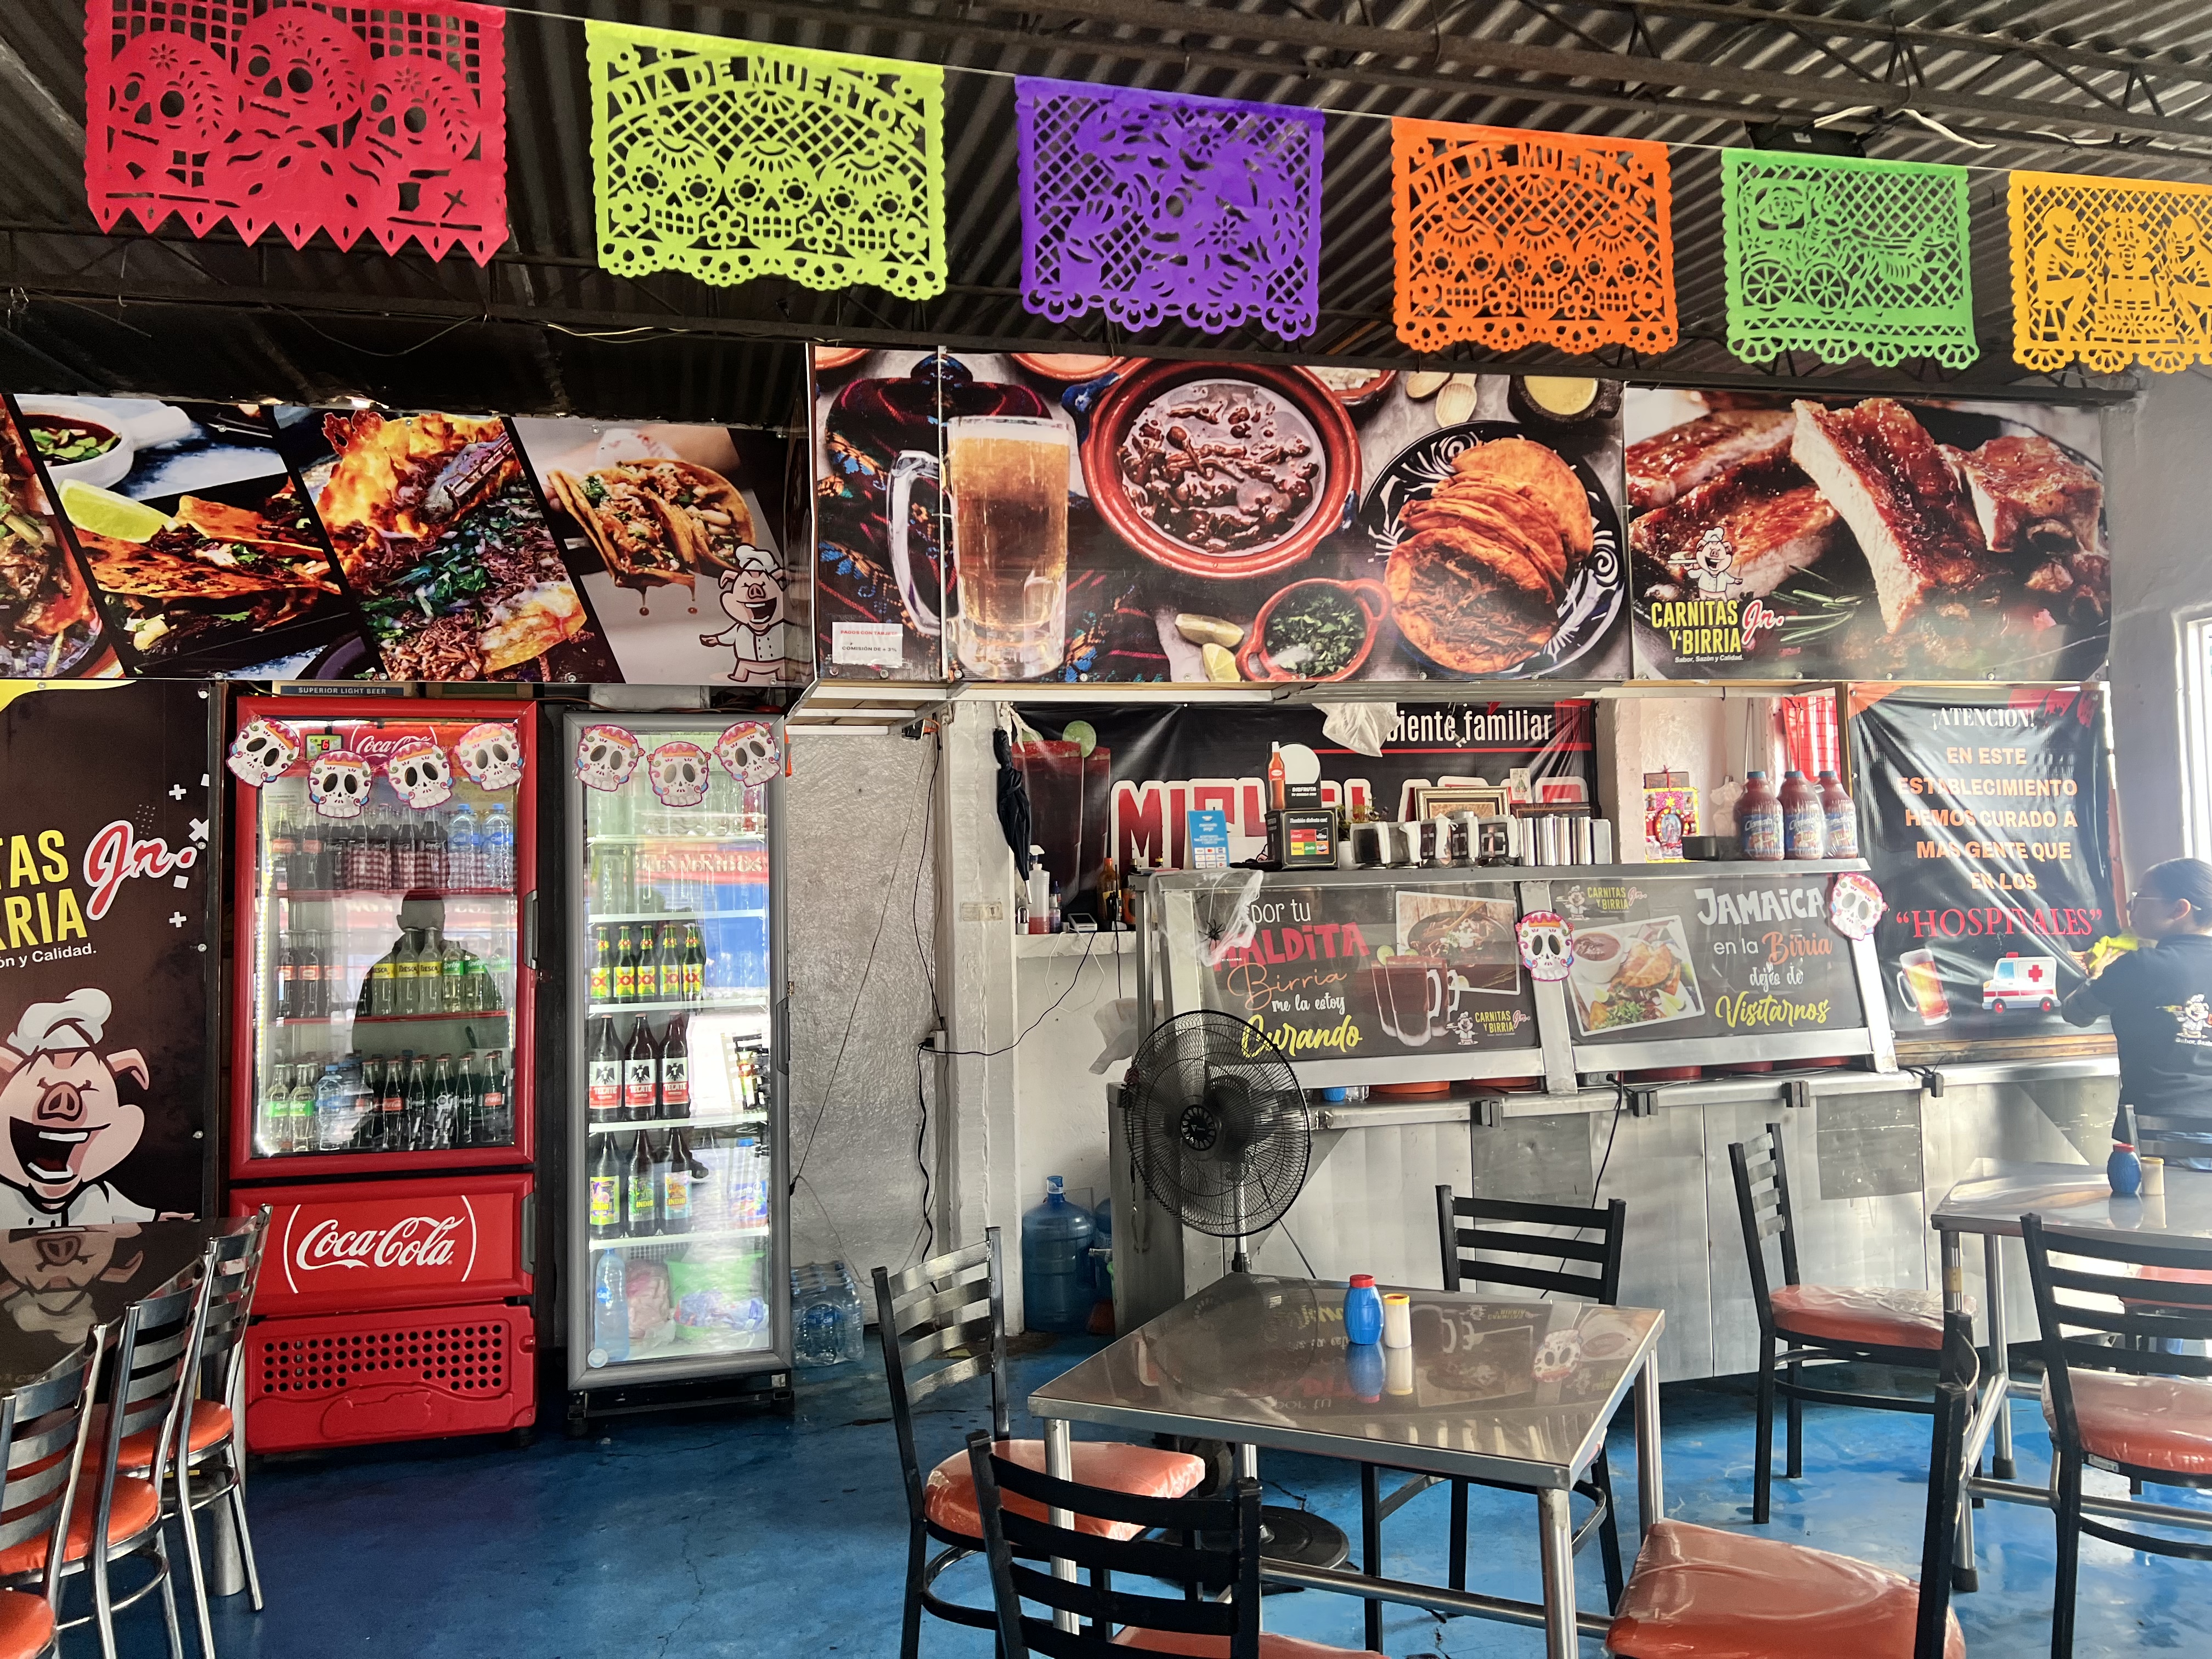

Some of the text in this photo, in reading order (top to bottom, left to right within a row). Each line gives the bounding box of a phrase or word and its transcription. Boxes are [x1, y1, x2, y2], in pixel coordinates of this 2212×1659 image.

[613, 74, 679, 113] DIA
[746, 56, 921, 143] MUERTOS
[1517, 142, 1656, 213] MUERTOS
[1651, 600, 1739, 628] CARNITAS
[1669, 628, 1742, 654] Y BIRRIA
[1463, 710, 1553, 742] familiar
[1946, 747, 2027, 766] EN ESTE
[1896, 777, 2078, 797] ESTABLECIMIENTO
[1905, 809, 2078, 828] HEMOS CURADO A
[0, 830, 69, 890] AS
[1916, 840, 2072, 862] MAS GENTE QUE
[1587, 886, 1627, 899] CARNITAS
[1971, 873, 2038, 890] EN LOS
[1251, 898, 1312, 924] por tu
[1596, 898, 1629, 910] Y BIRRIA
[0, 888, 88, 950] RIA
[19, 955, 27, 968] y
[32, 942, 97, 962] Calidad.
[1713, 931, 1833, 965] en la Birria
[443, 961, 460, 969] Sprite
[1786, 964, 1804, 985] de
[1227, 957, 1347, 1011] Birria
[1272, 992, 1346, 1015] me la estoy
[1715, 991, 1831, 1028] Visitarnos
[1474, 1010, 1511, 1023] CARNITAS
[1483, 1021, 1514, 1033] Y BIRRIA
[1241, 1014, 1363, 1058] Curando
[593, 1086, 618, 1095] TECATE
[629, 1084, 653, 1093] TECATE
[663, 1082, 687, 1091] TECATE
[636, 1199, 653, 1208] INDIO
[668, 1197, 686, 1205] INDIO
[296, 1216, 466, 1271] Coca-Cola
